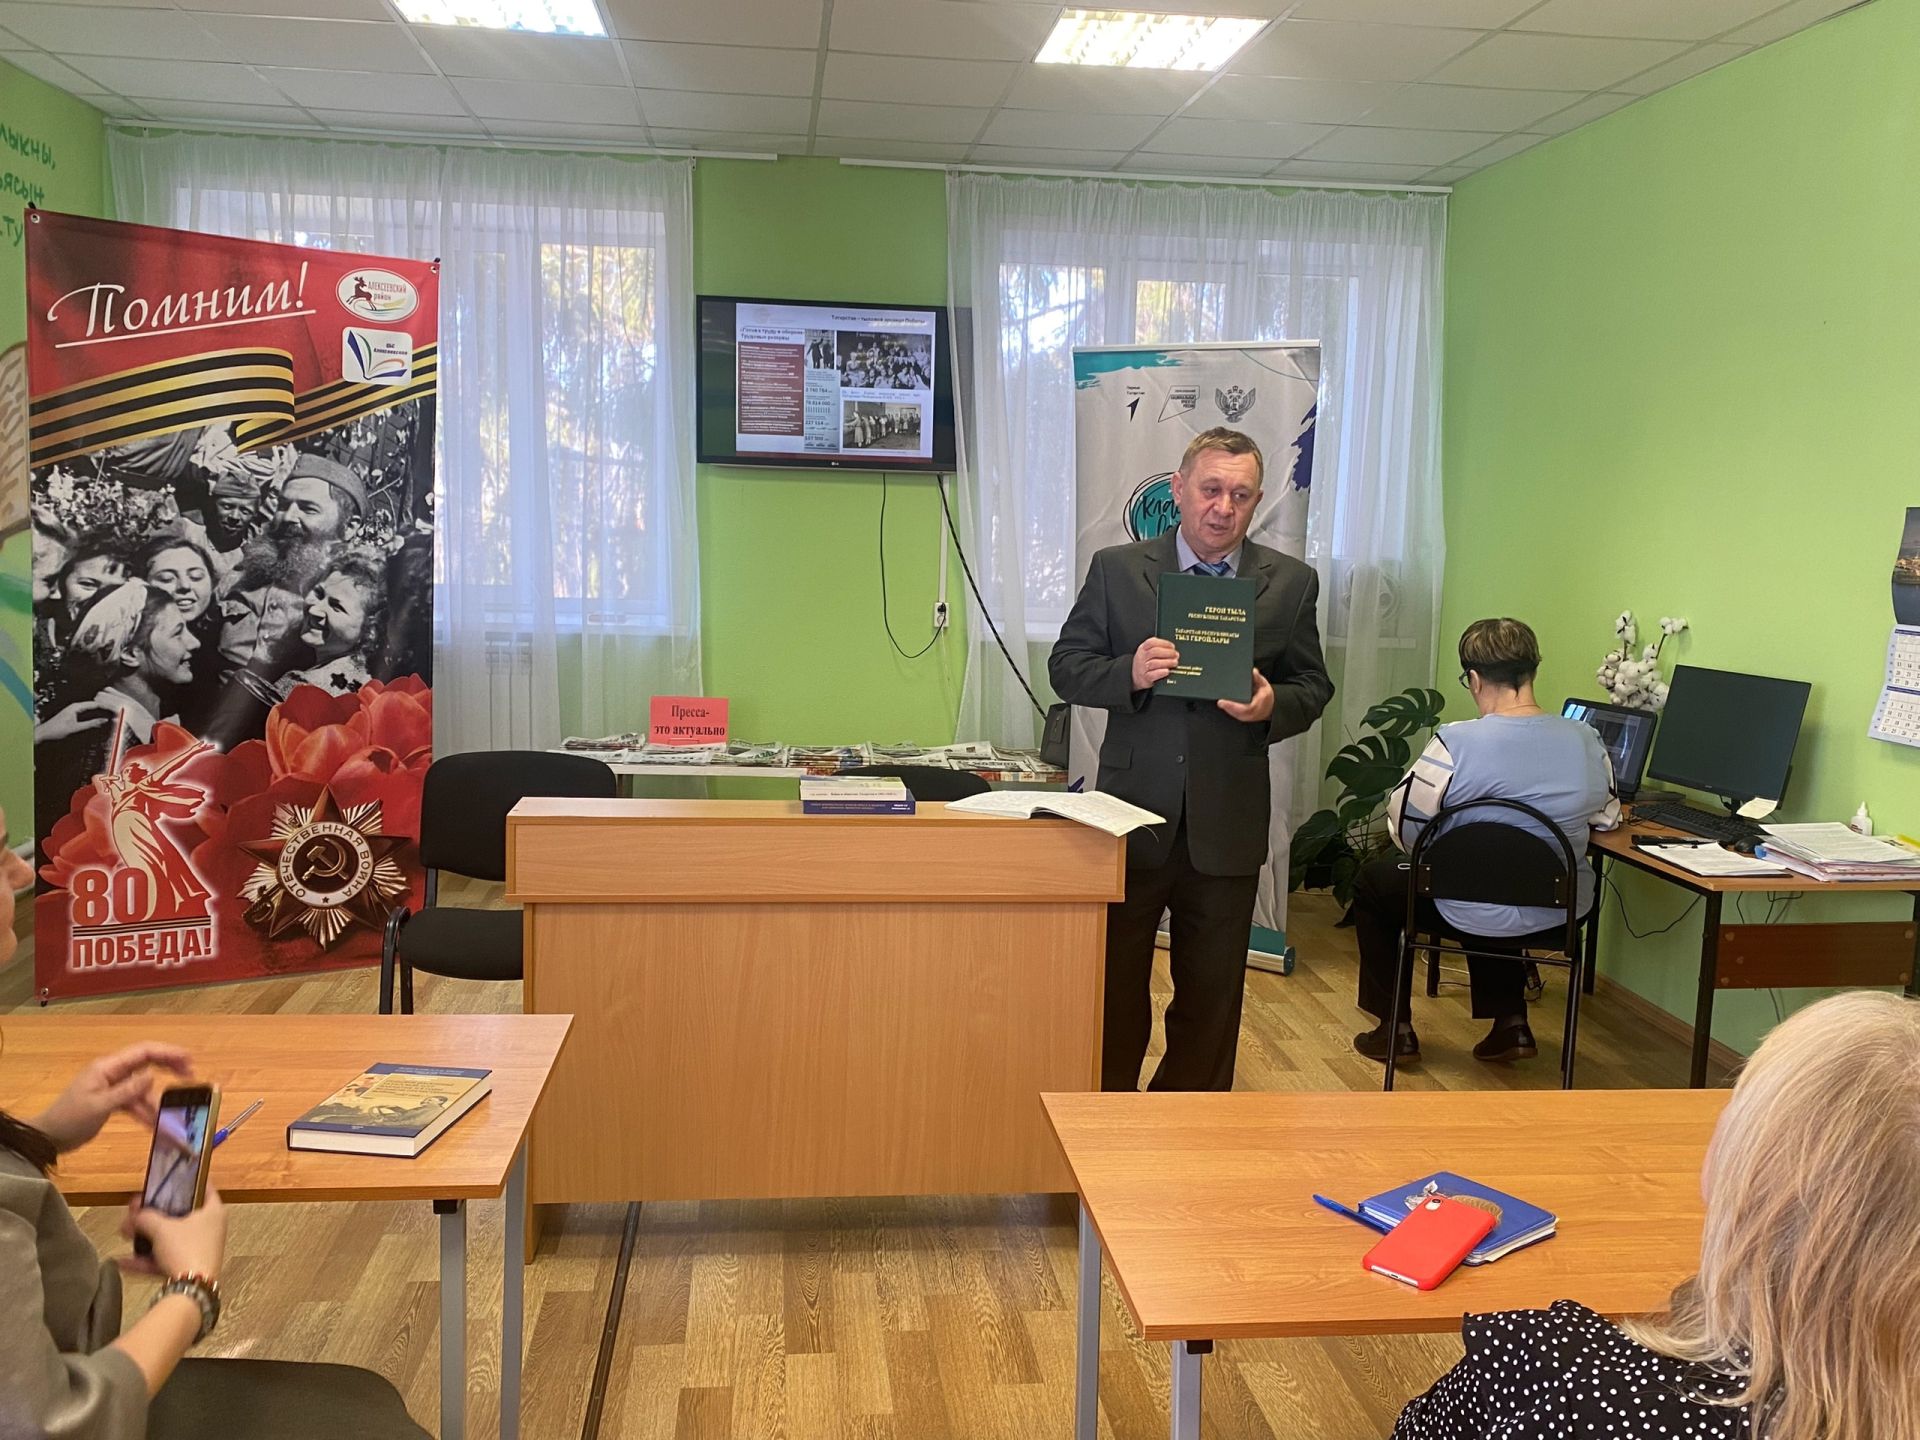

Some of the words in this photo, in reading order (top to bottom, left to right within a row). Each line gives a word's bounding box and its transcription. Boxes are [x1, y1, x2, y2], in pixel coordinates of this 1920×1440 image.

[47, 261, 309, 338] Помним!
[654, 726, 671, 735] это
[673, 726, 725, 738] актуально
[671, 705, 710, 720] Пресса-
[282, 824, 364, 898] ОТЕЧЕСТВЕННАЯ
[72, 868, 149, 926] 80
[72, 927, 213, 969] ПОБЕДА!
